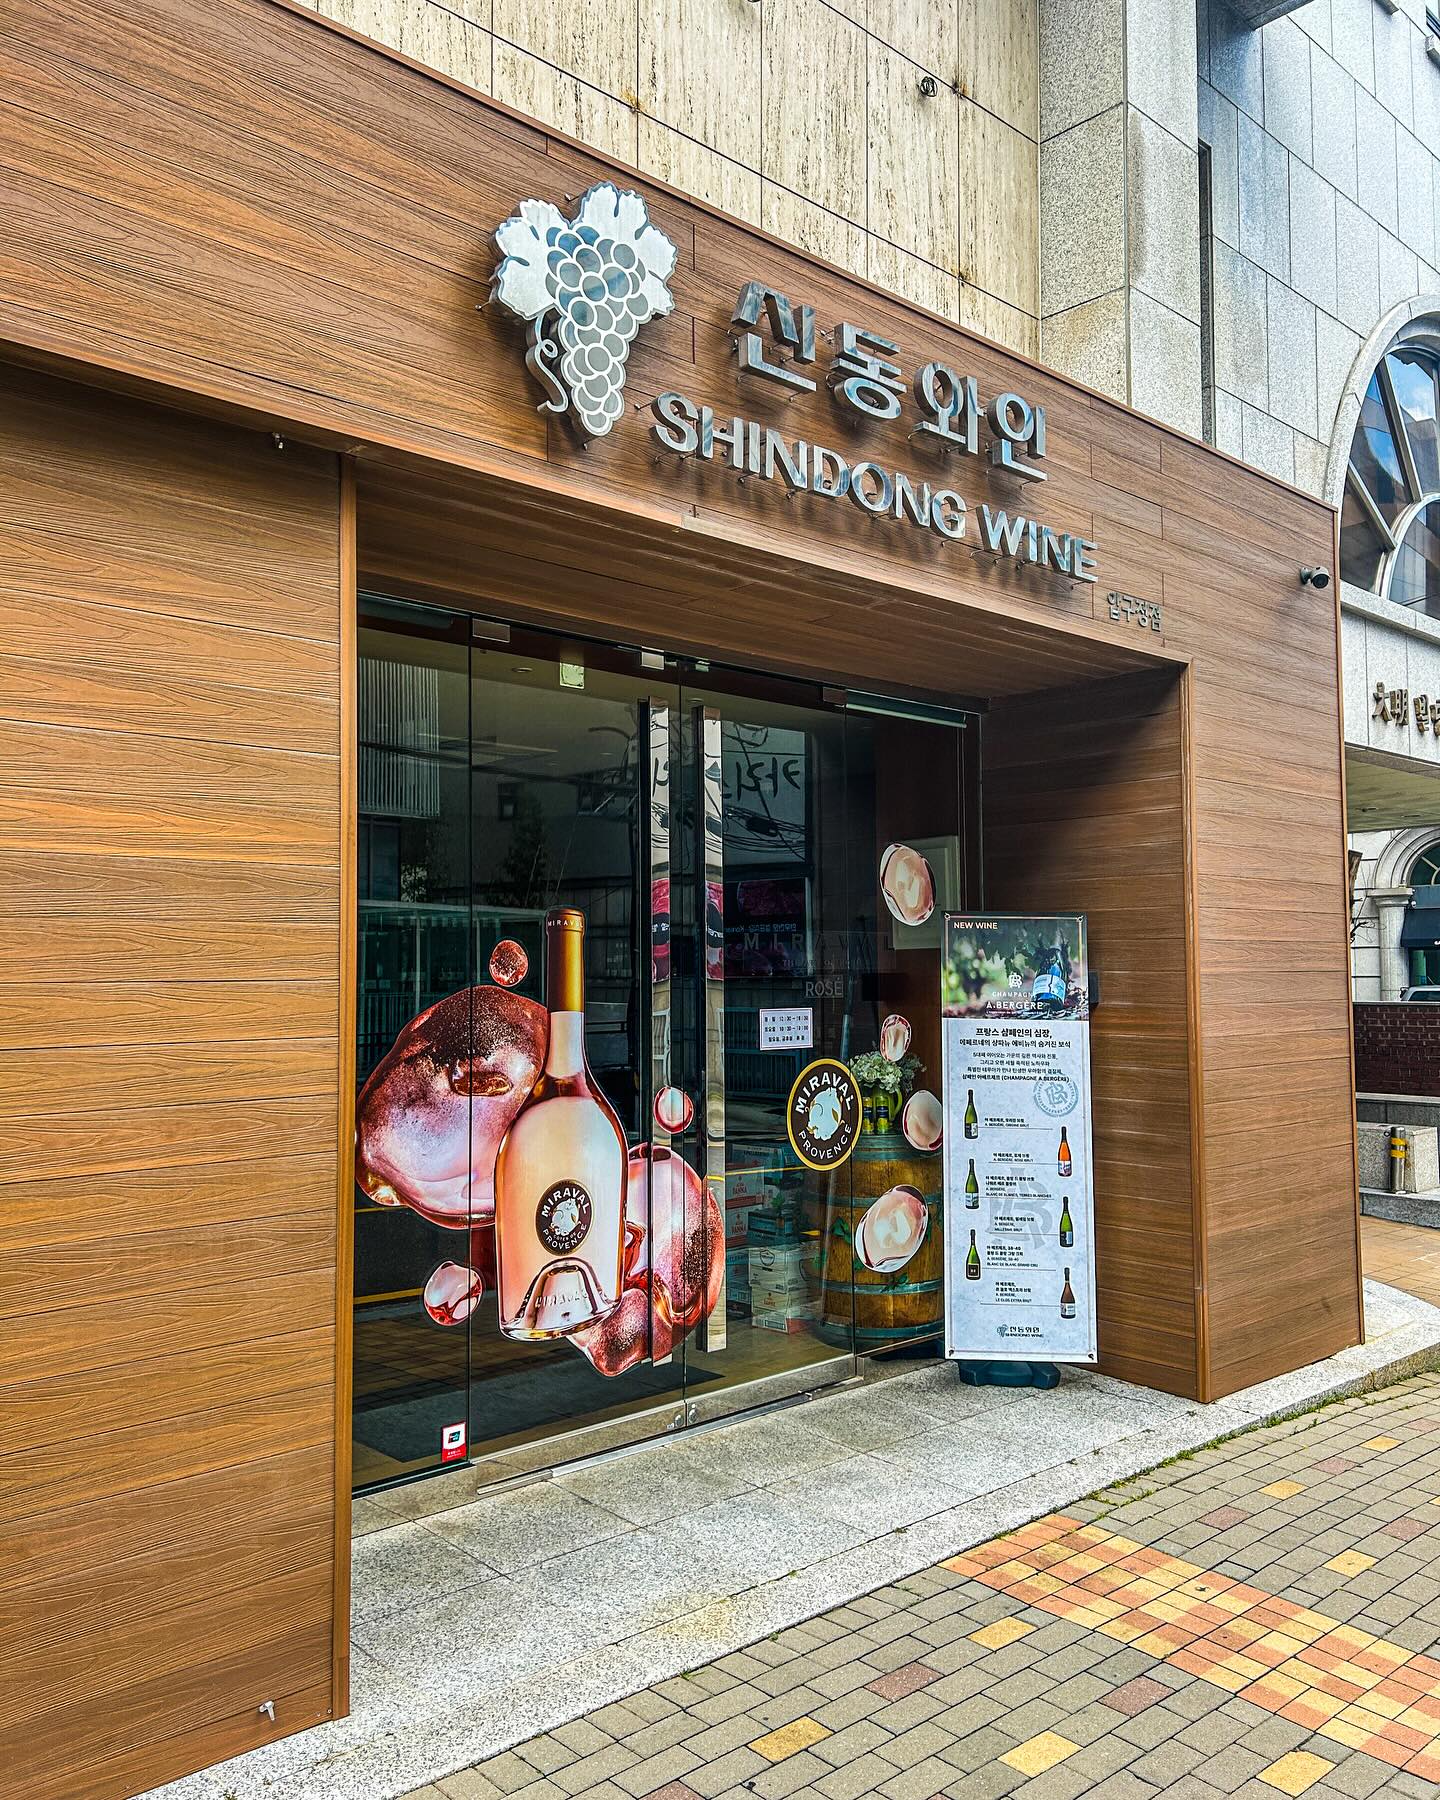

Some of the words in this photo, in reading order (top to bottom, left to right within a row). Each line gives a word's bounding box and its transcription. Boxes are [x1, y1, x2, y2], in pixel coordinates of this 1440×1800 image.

[732, 281, 1048, 483] 신동와인
[652, 392, 966, 539] SHINDONG
[976, 504, 1099, 584] WINE
[1107, 592, 1161, 632] 압구정점
[953, 921, 973, 929] NEW
[805, 976, 843, 997] ROSÉ
[976, 1027, 999, 1036] 프랑스
[795, 1072, 854, 1114] MIRAVAL
[798, 1124, 852, 1160] PROVENCE
[541, 1187, 590, 1218] MIRAVAL
[543, 1224, 587, 1250] PROVENCE
